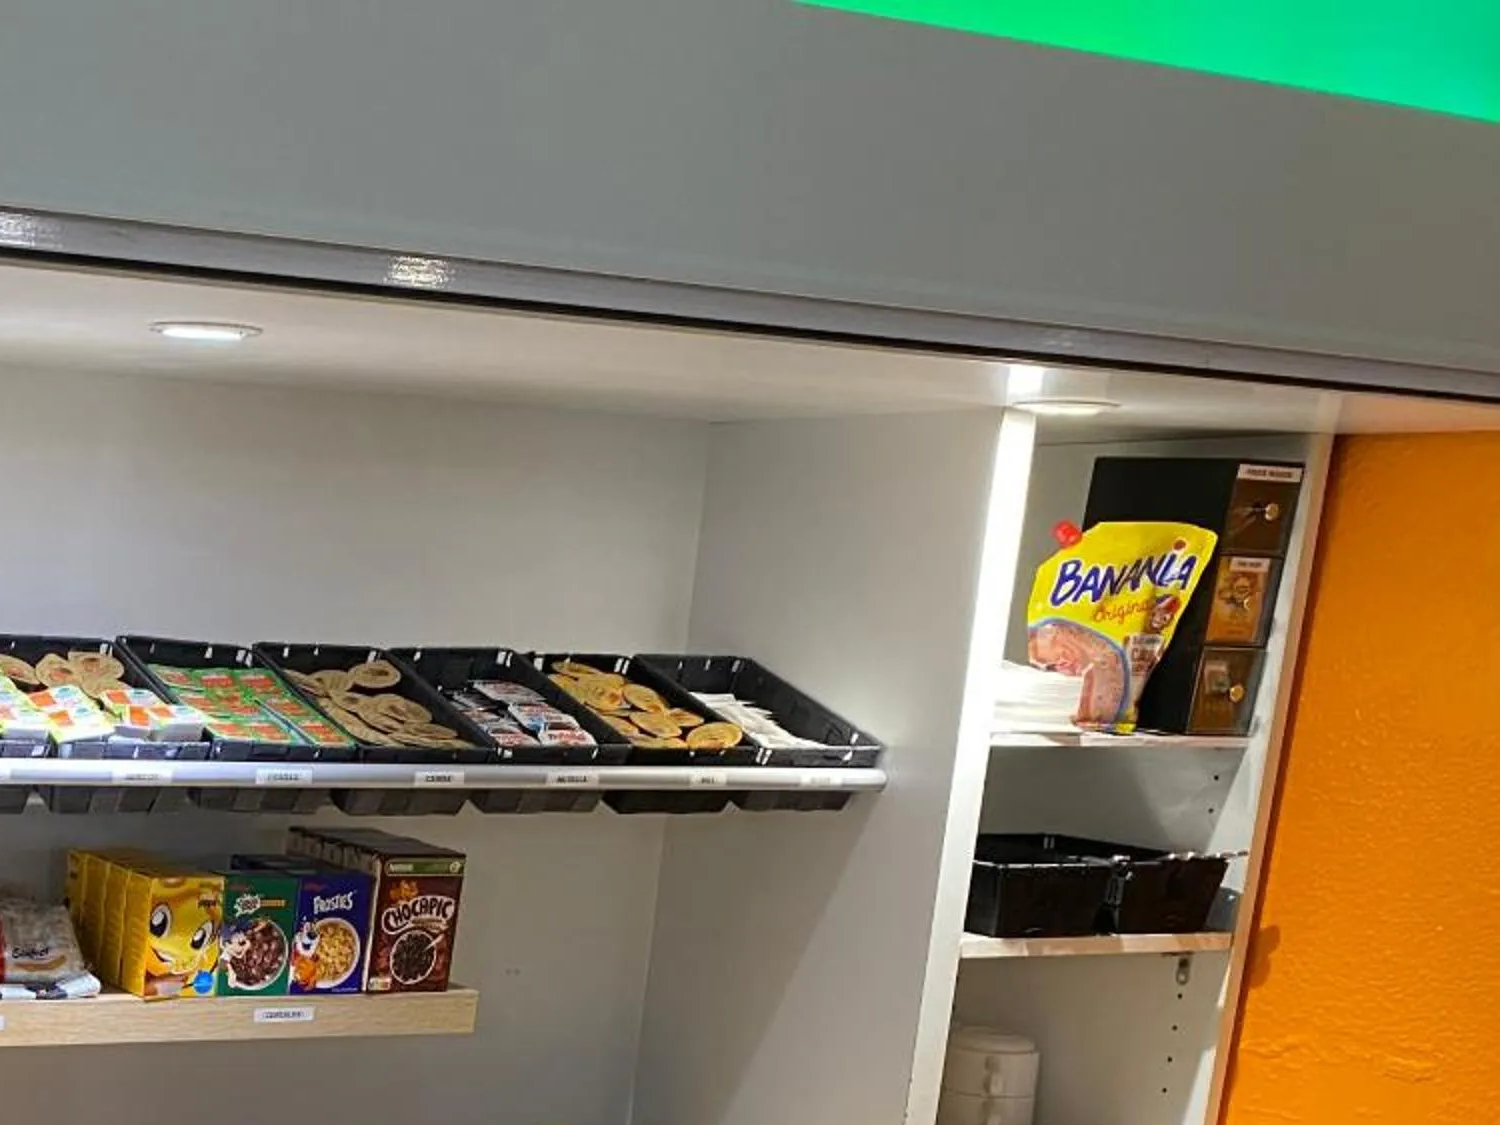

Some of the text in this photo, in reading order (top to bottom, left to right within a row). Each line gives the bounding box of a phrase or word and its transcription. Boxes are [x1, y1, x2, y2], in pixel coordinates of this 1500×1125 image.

[1051, 537, 1198, 606] BANANIA
[1092, 601, 1155, 625] Origina
[313, 890, 355, 915] FROSTIES
[383, 896, 454, 933] CHOCAPIC
